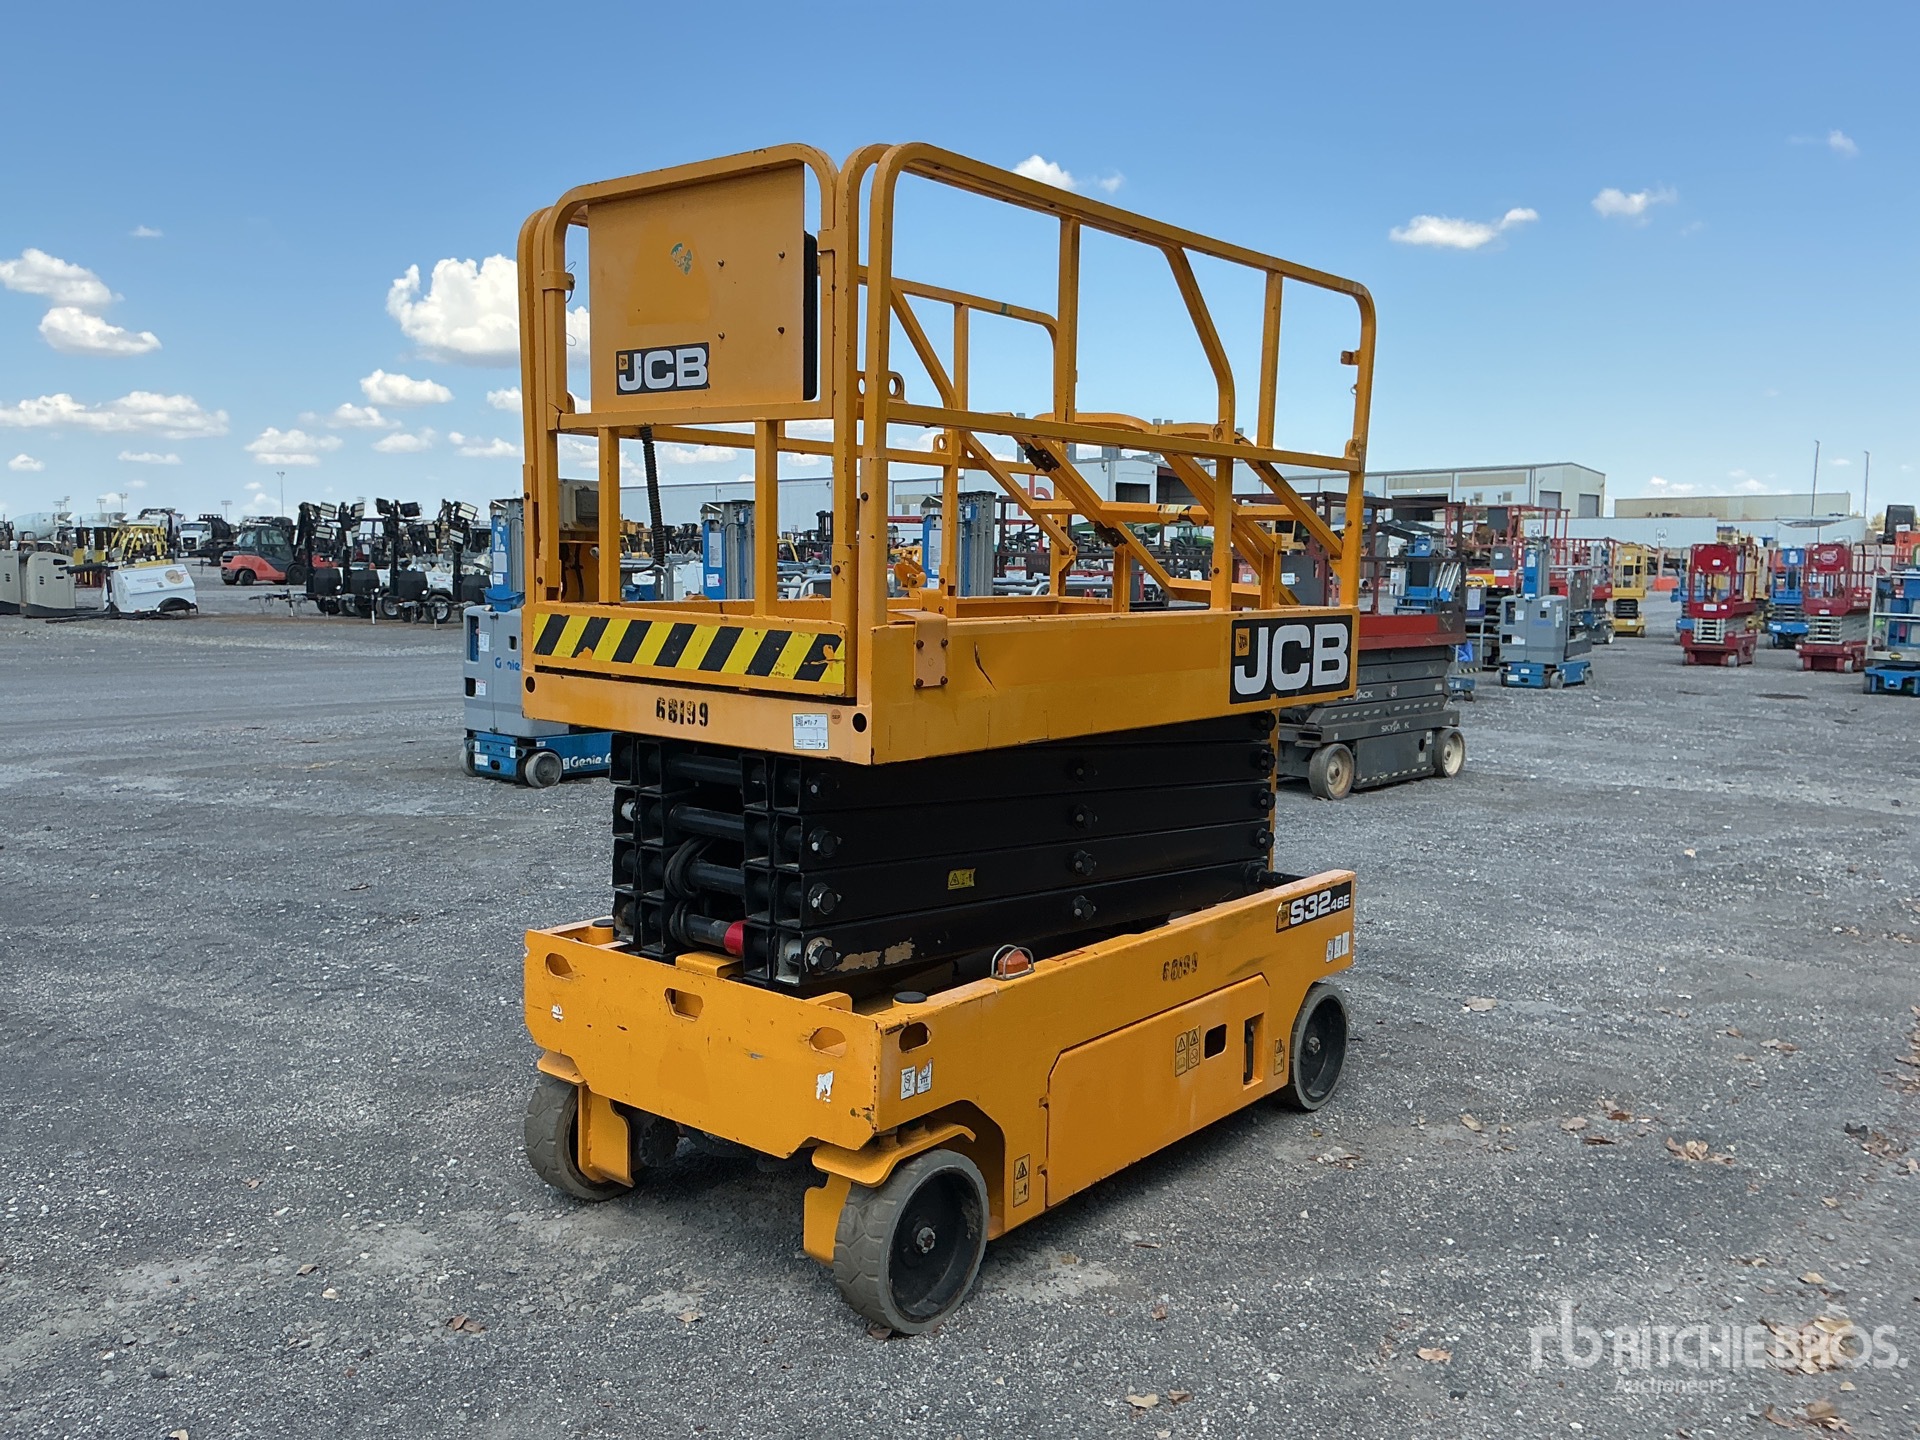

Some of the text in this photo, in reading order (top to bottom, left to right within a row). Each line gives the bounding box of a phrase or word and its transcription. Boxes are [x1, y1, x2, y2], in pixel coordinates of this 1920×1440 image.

[619, 347, 708, 391] JCB
[494, 657, 520, 671] Gnie
[1234, 623, 1348, 695] JCB
[656, 697, 709, 728] 68199
[1381, 721, 1410, 733] SKYJAK
[570, 754, 602, 768] Genie
[1290, 890, 1350, 925] S32 46E
